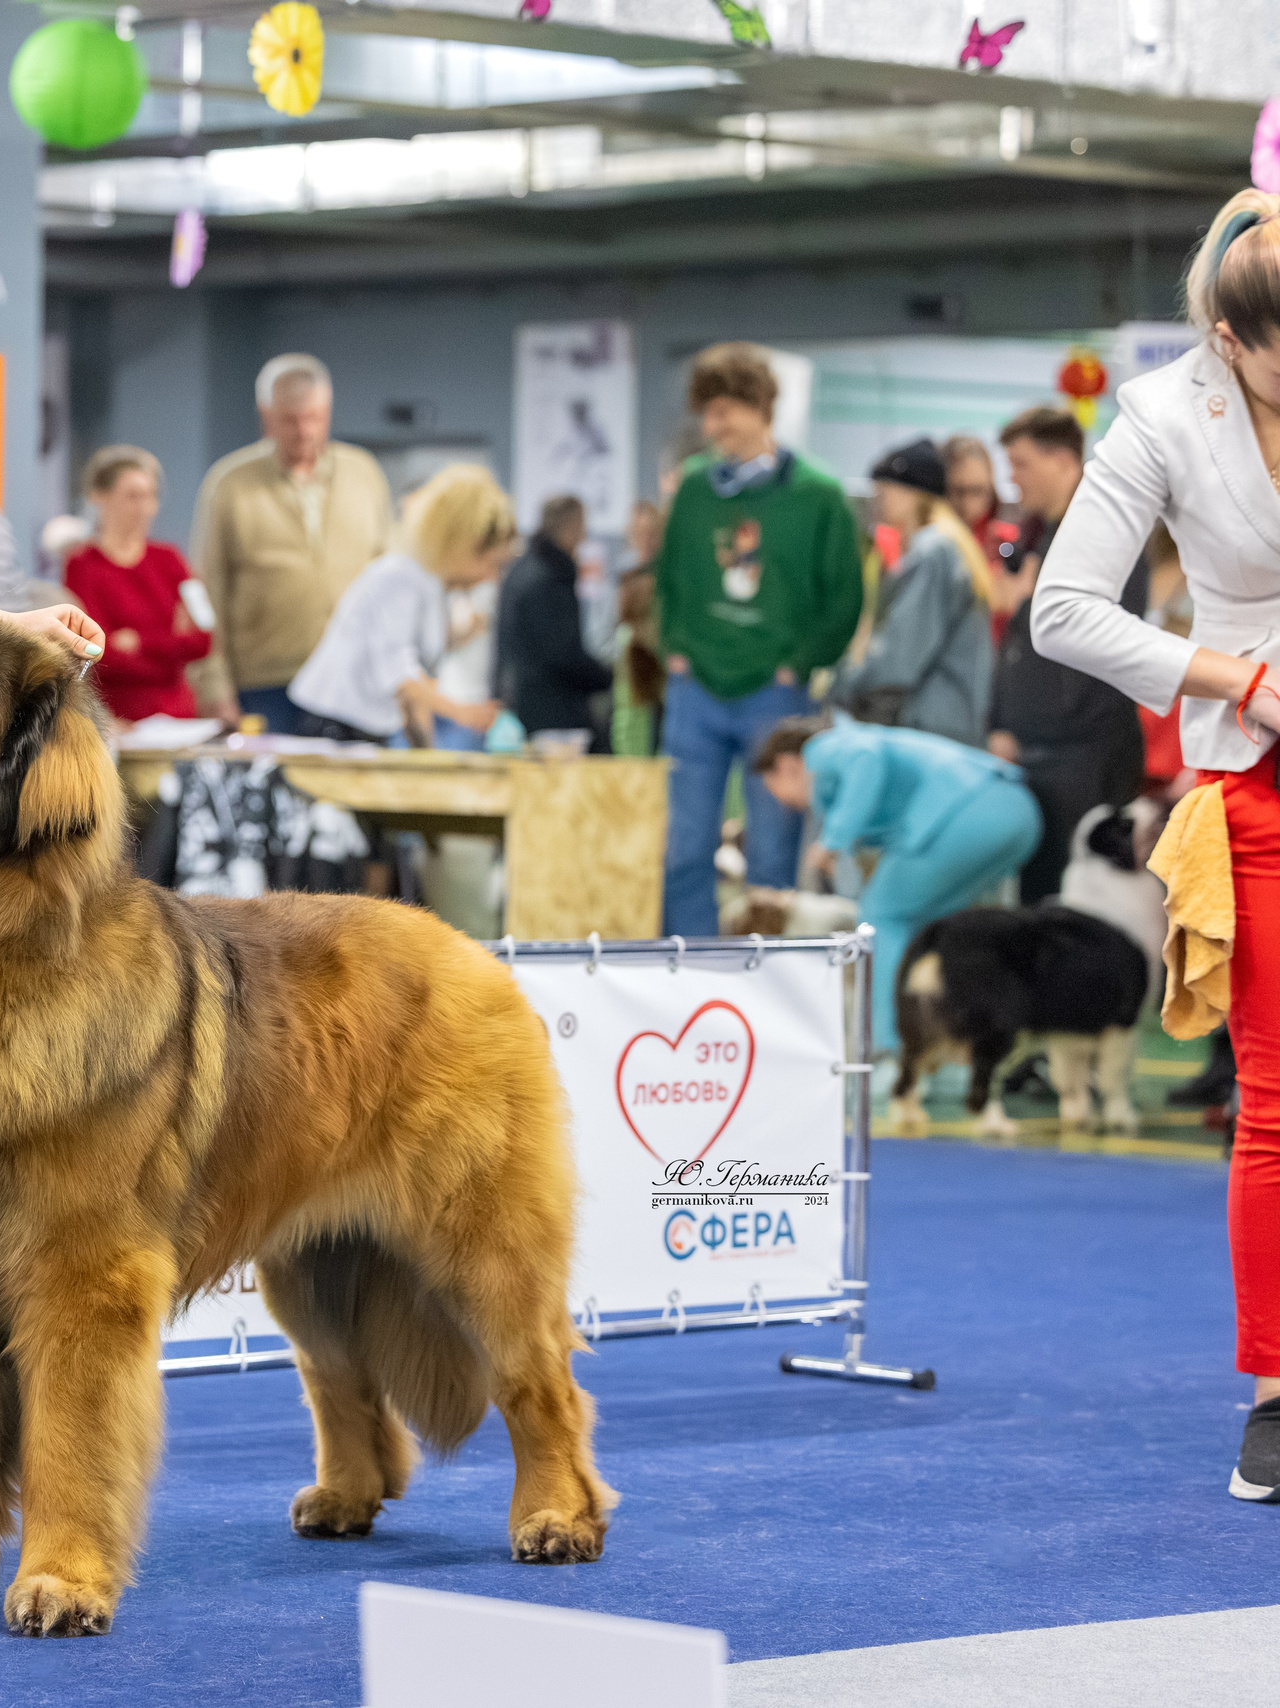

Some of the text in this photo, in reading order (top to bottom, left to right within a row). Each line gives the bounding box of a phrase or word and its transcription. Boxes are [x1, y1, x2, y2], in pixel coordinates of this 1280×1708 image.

[696, 1041, 738, 1063] ЭТО
[633, 1081, 728, 1105] ЛЮБОВЬ
[663, 1209, 796, 1260] СФЕРА
